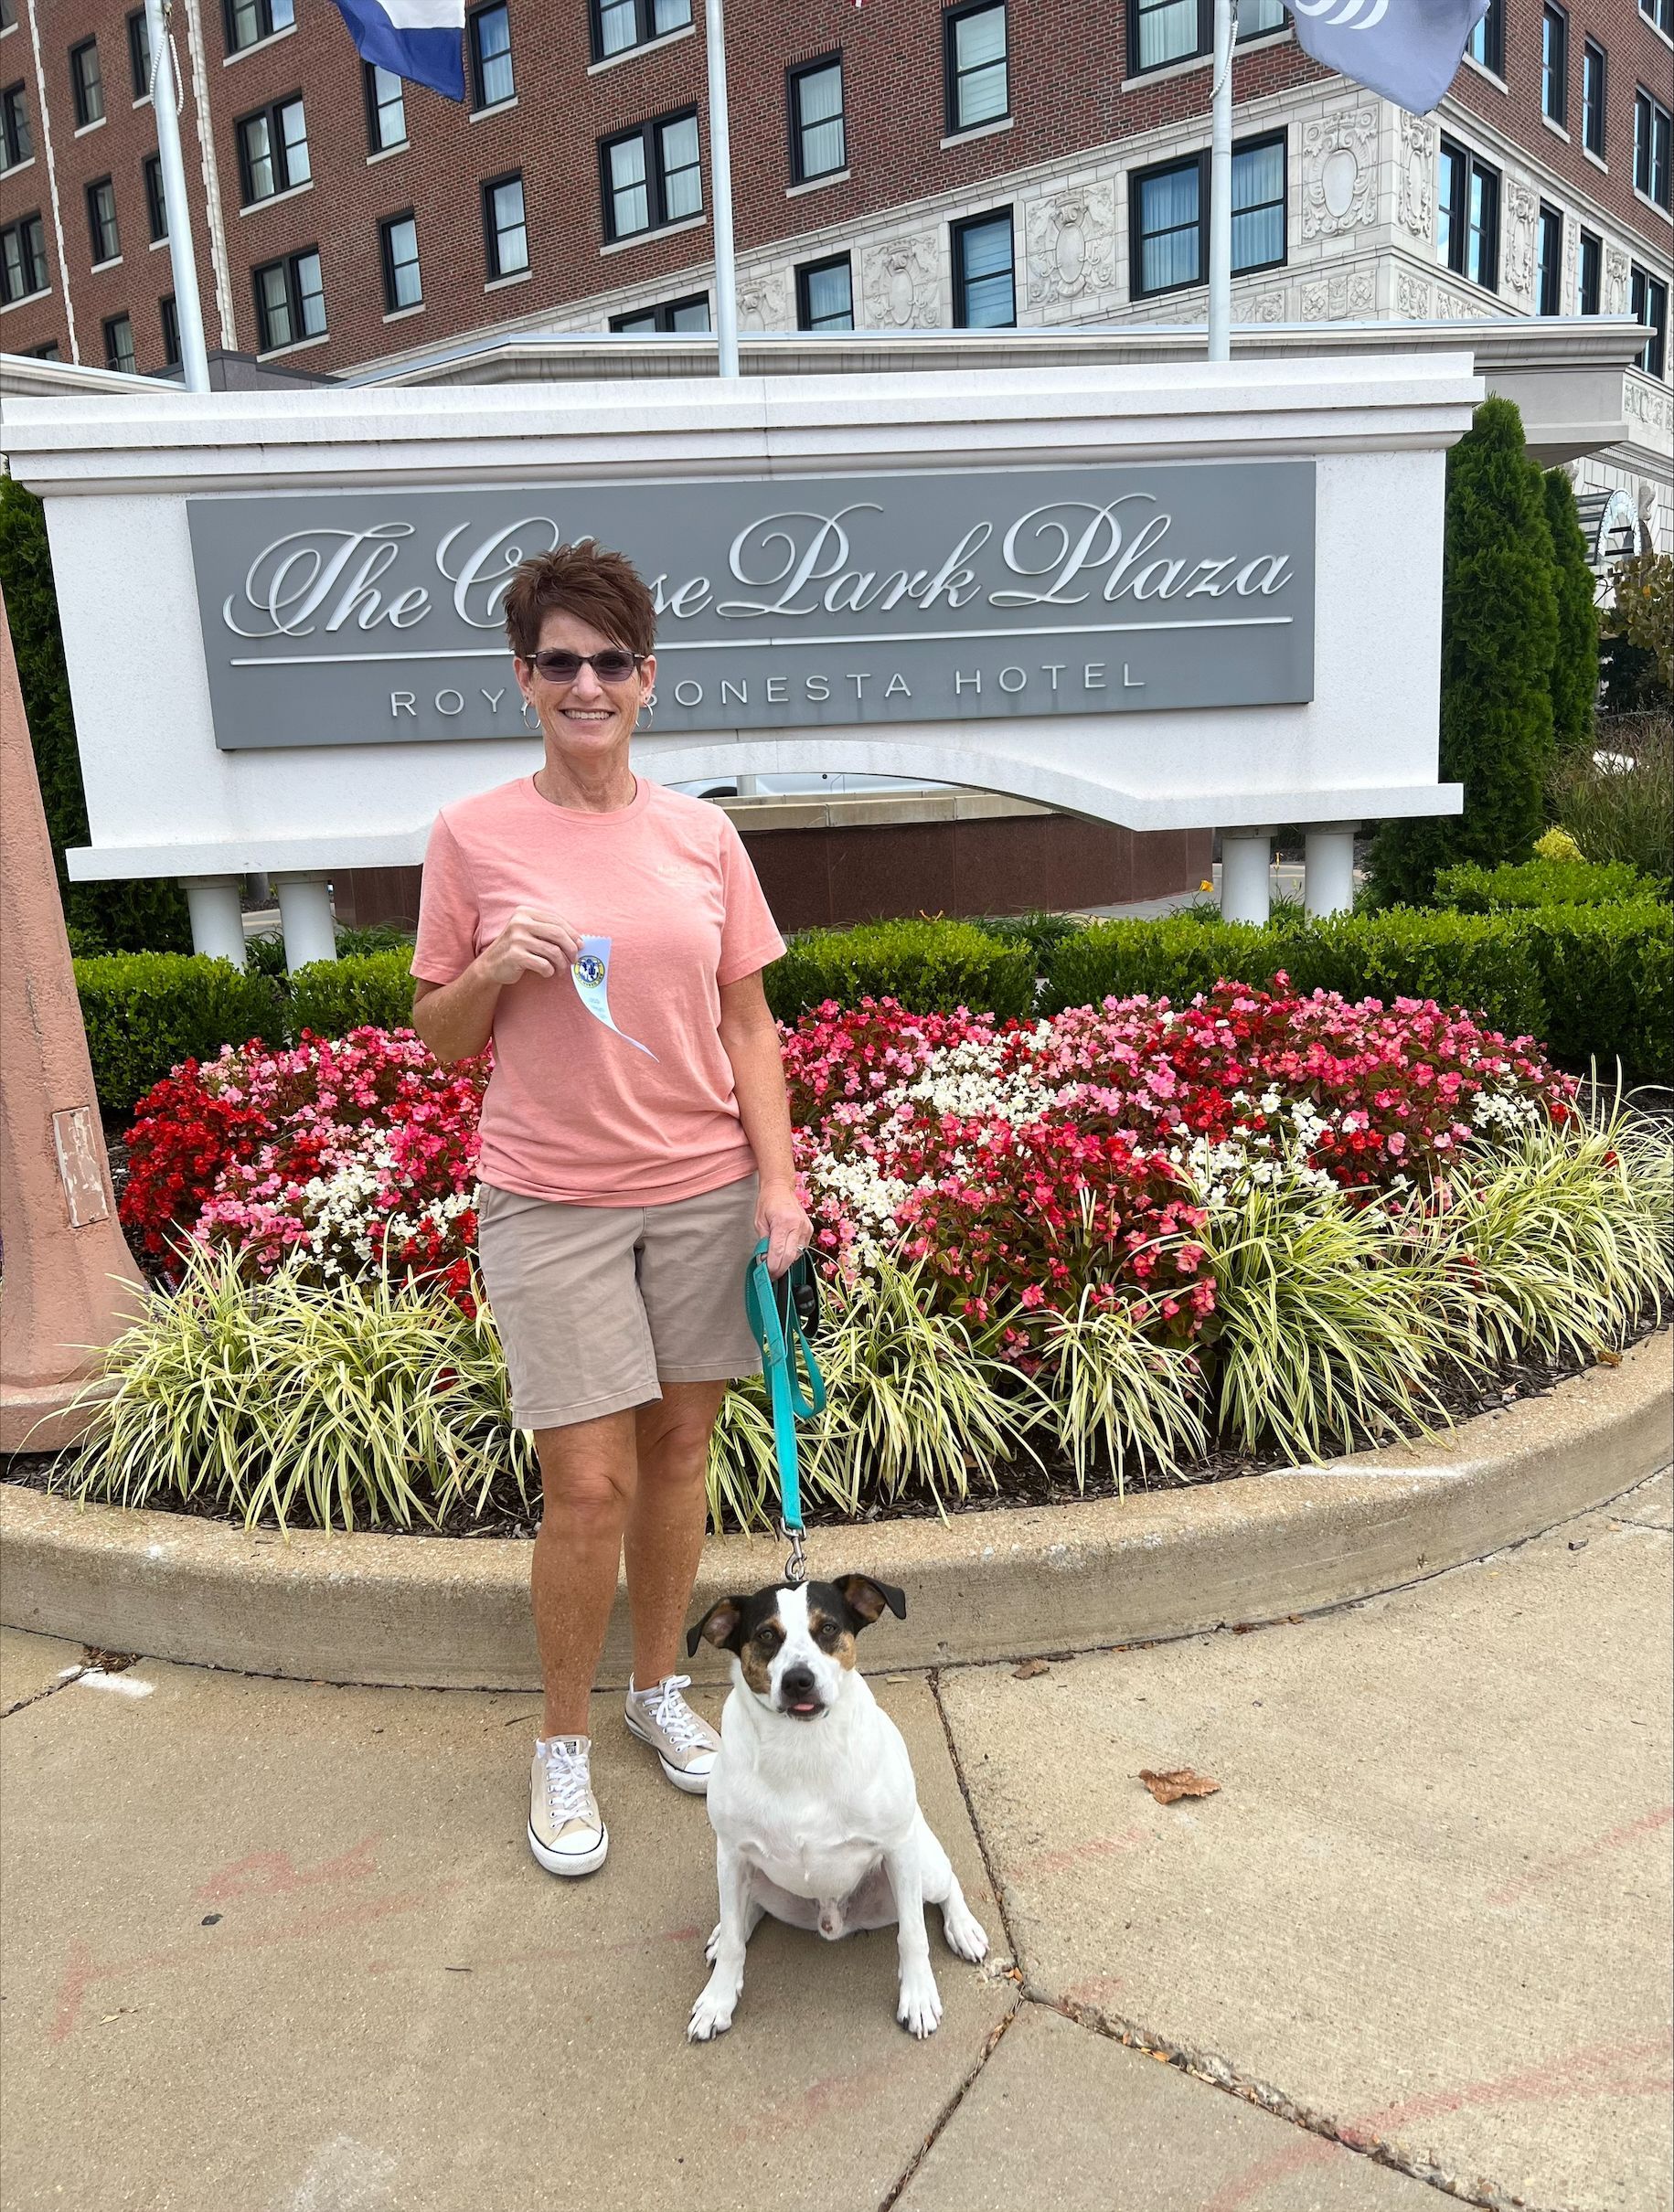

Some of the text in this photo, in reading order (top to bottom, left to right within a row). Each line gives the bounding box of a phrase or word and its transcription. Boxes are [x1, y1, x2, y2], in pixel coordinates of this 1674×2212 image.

[222, 492, 1295, 637] The Cse Park Plaza
[389, 687, 526, 717] ROY
[955, 662, 1146, 696] HOTEL
